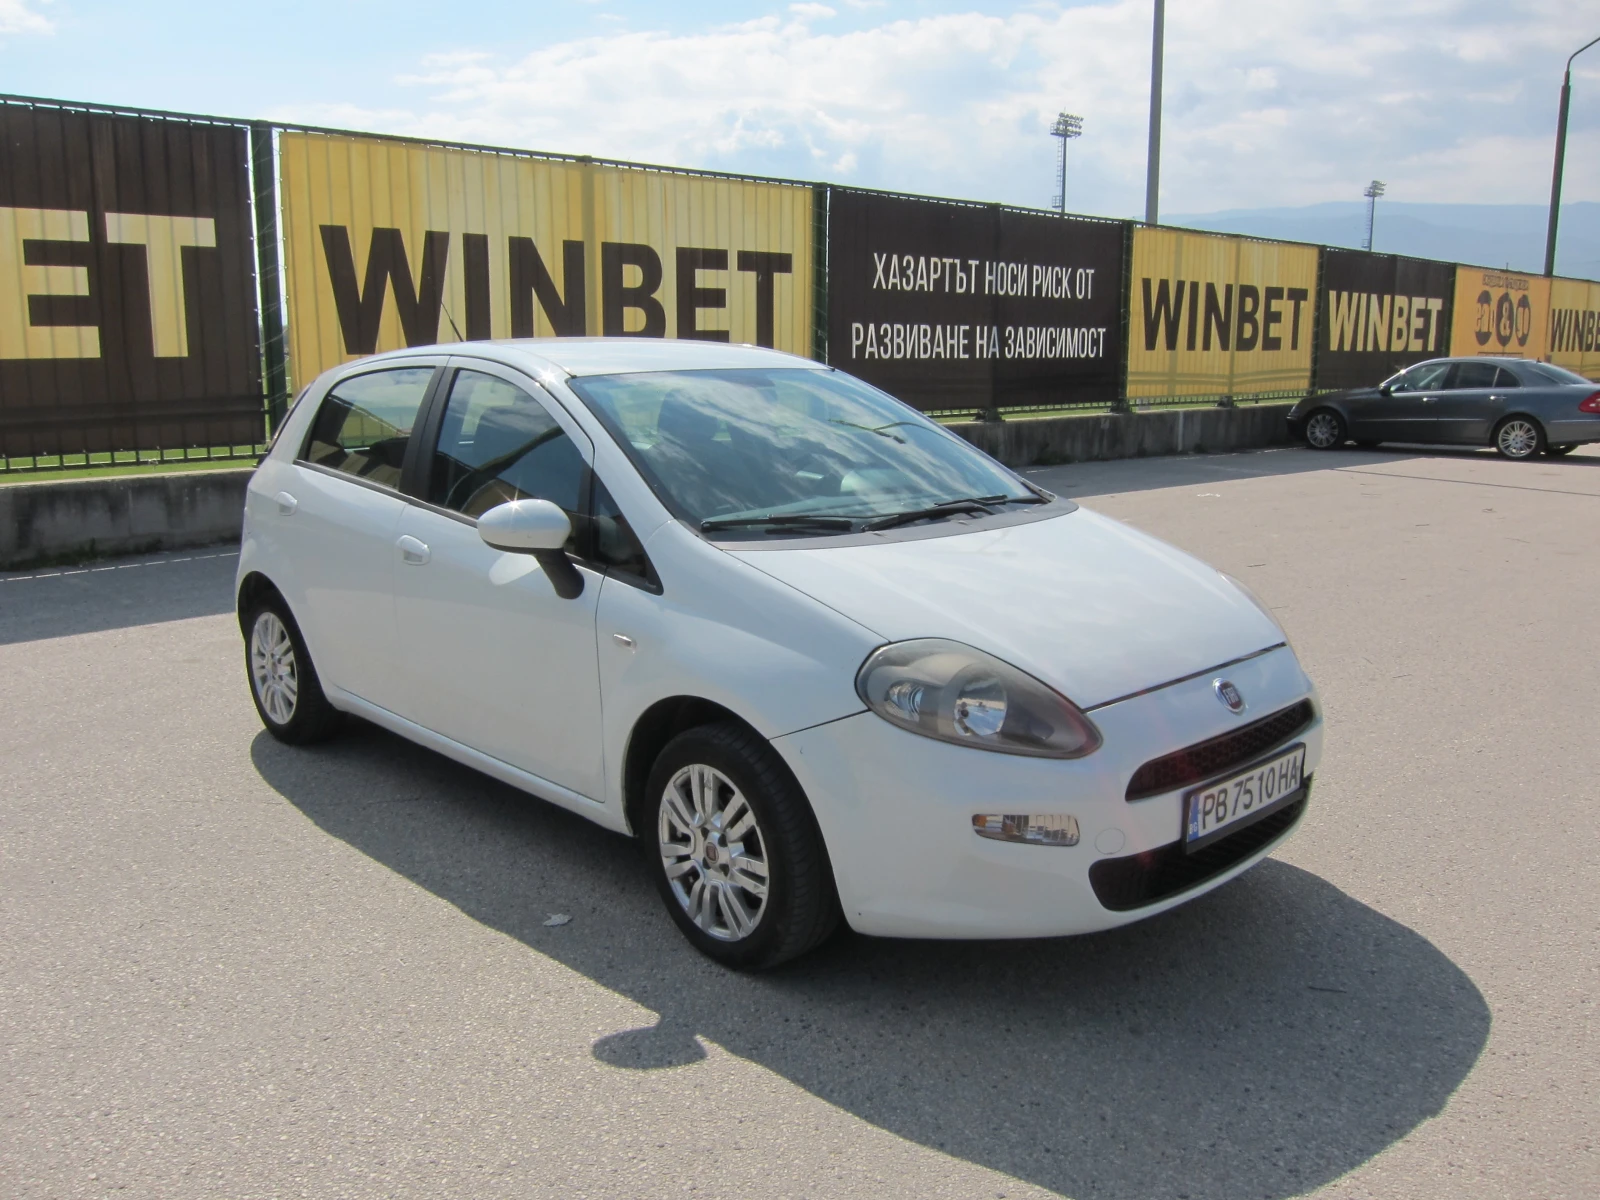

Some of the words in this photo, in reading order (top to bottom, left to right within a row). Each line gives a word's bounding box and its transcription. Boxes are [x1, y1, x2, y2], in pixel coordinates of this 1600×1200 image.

[0, 206, 217, 359] ET
[319, 224, 792, 356] WINBET
[873, 252, 980, 295] ХАЗАРТЪТ
[984, 261, 1028, 297] НОСИ
[1032, 265, 1071, 299] РИСК
[1076, 268, 1095, 300] ОТ
[851, 322, 970, 359] РАЗВИВАНЕ
[976, 325, 1000, 359] НА
[1005, 325, 1106, 359] ЗАВИСИМОСТ
[1142, 277, 1309, 351] WINBET
[1329, 290, 1443, 352] WINBET
